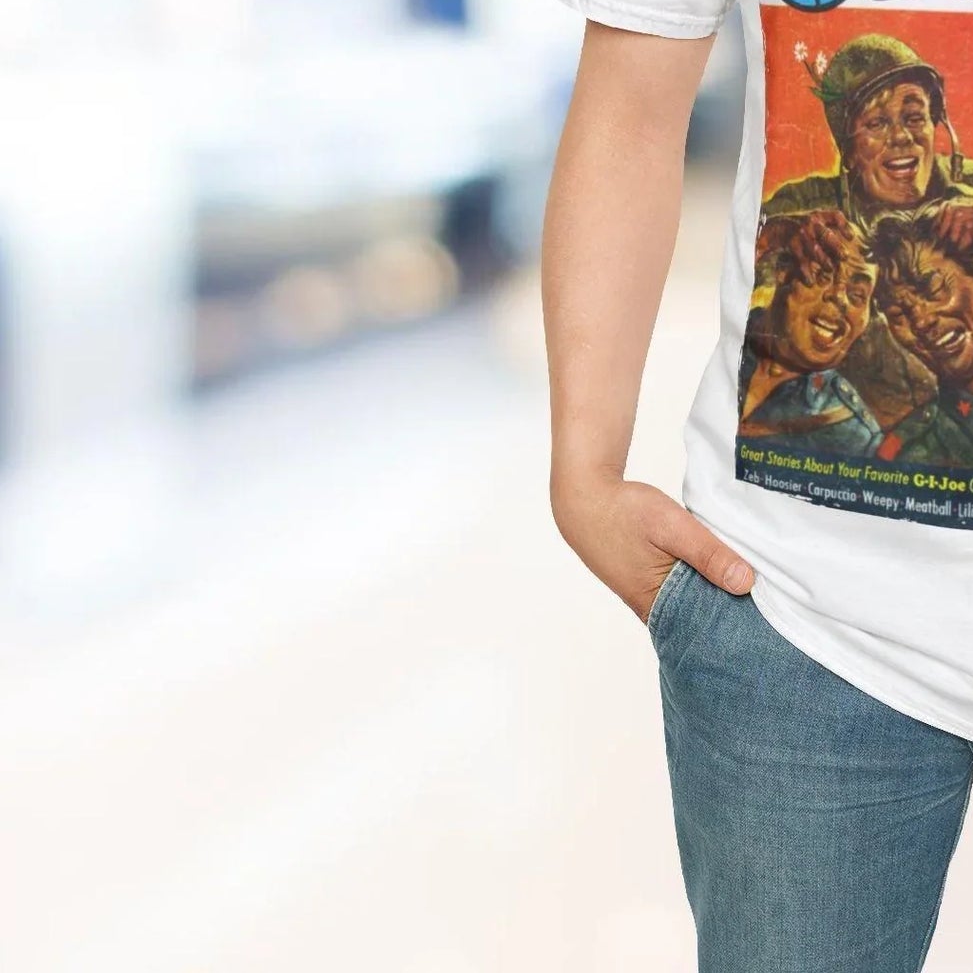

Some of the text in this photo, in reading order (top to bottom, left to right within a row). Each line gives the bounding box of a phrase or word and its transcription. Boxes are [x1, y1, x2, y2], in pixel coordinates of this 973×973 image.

[741, 445, 764, 462] Great
[767, 451, 801, 469] Stories
[804, 457, 834, 475] About
[838, 461, 862, 479] Your
[864, 465, 910, 485] Favorite
[743, 468, 760, 483] Zeb
[765, 474, 802, 492] Hoosier
[808, 482, 857, 502] Carpuccio
[862, 489, 899, 512] Weepy
[904, 496, 952, 516] Meatball
